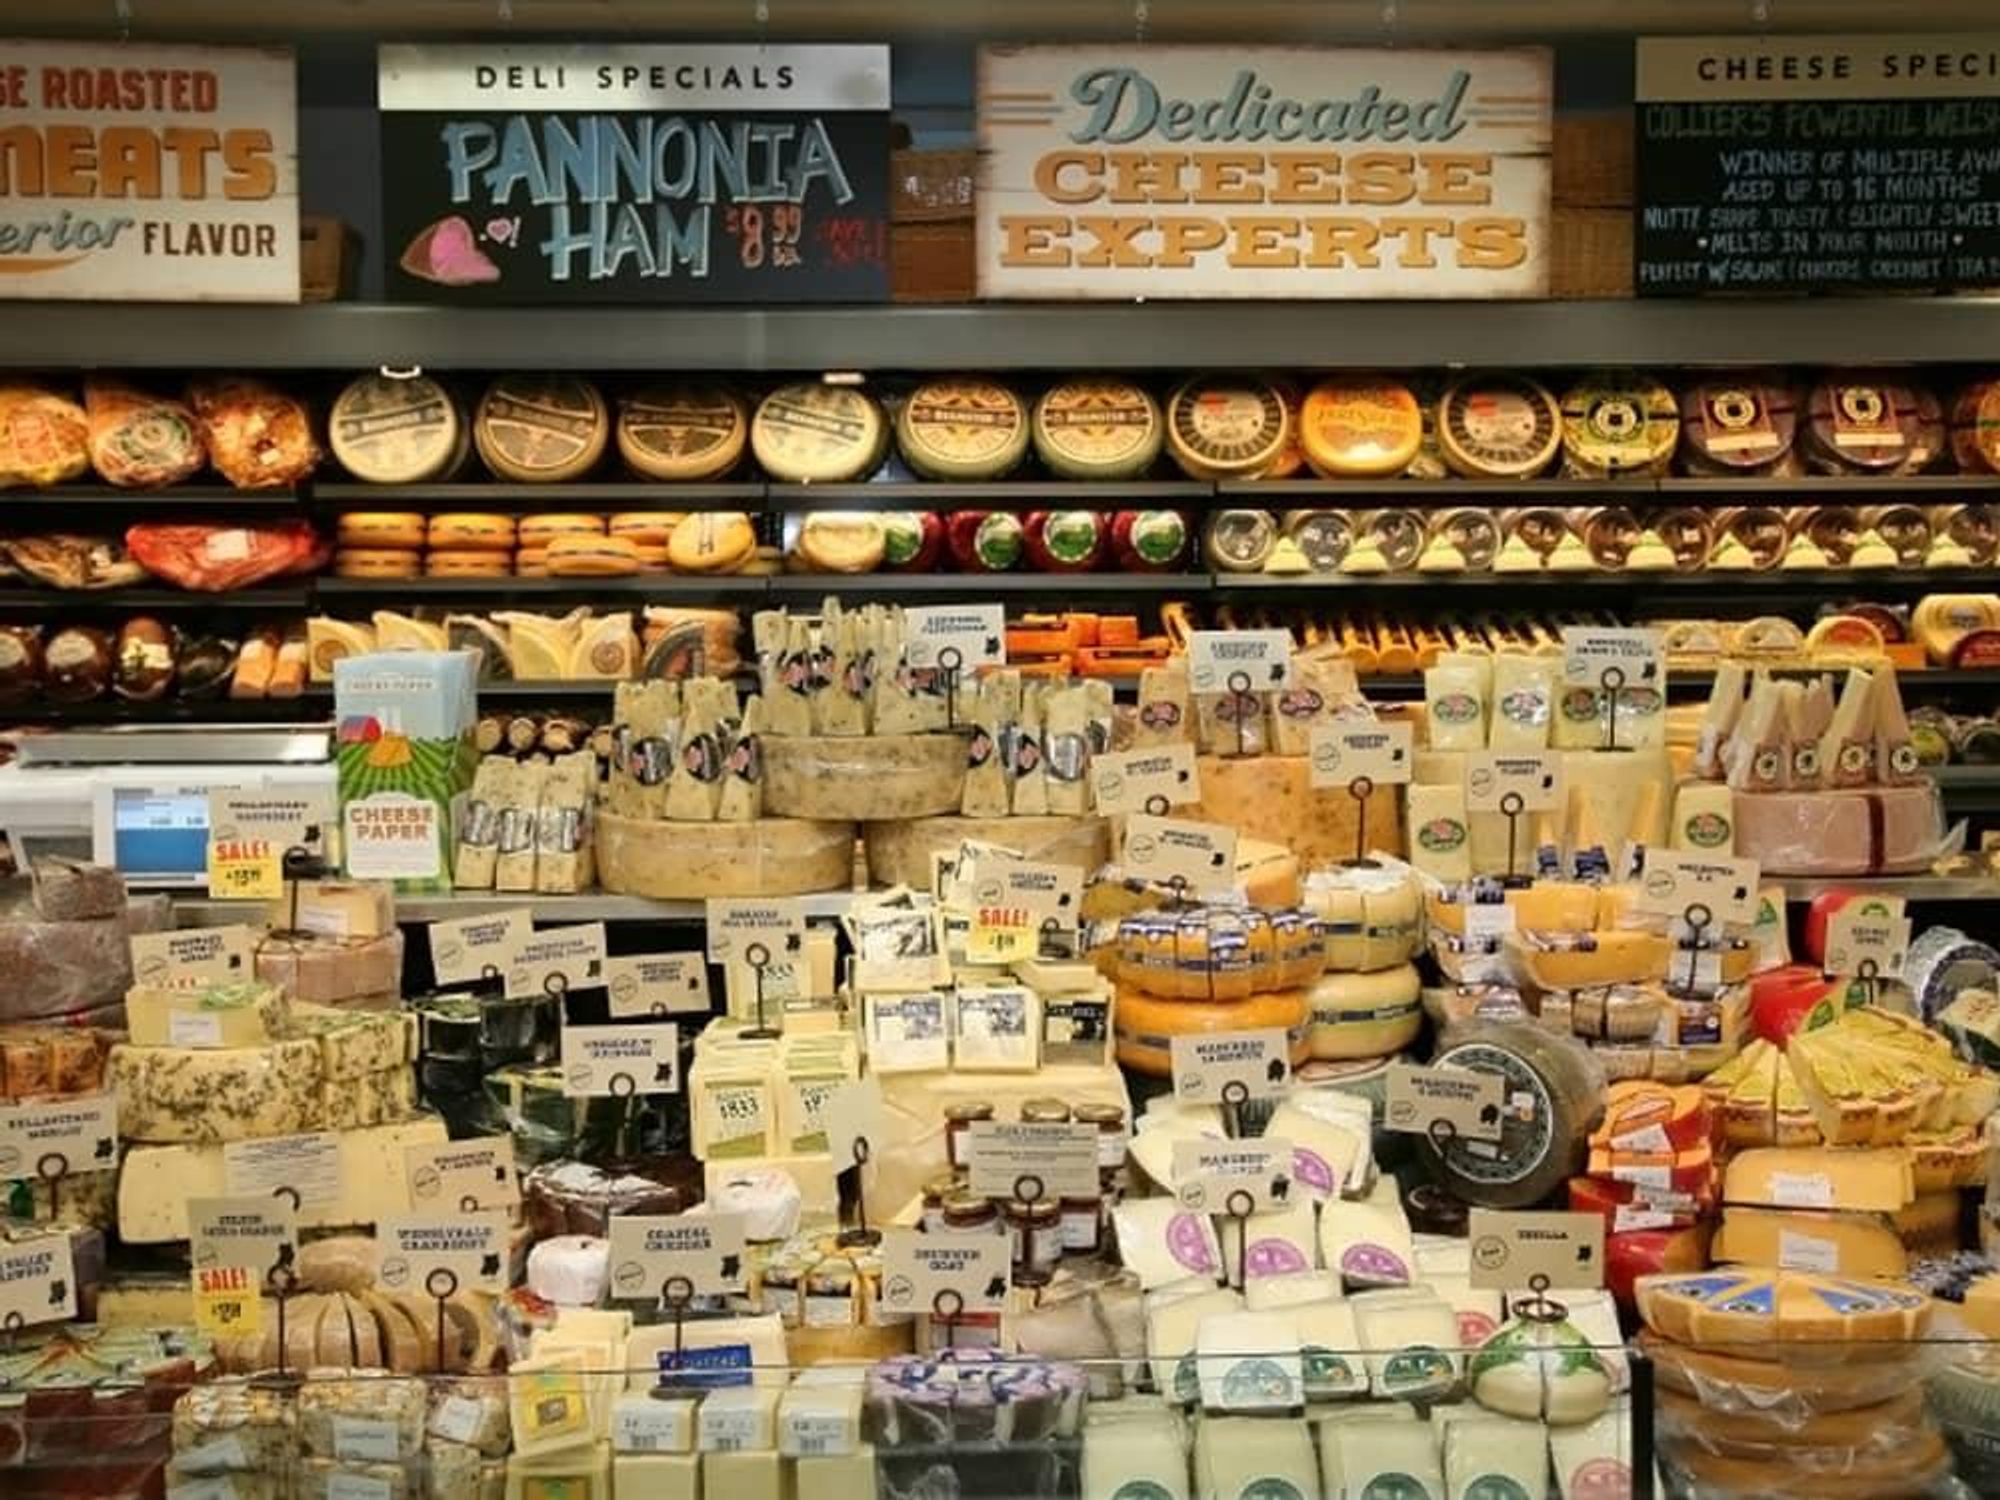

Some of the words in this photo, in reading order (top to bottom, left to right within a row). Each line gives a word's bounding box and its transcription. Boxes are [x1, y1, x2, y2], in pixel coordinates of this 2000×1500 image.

[475, 65, 566, 89] DELI
[597, 65, 796, 90] SPECIALS
[1697, 55, 1851, 81] CHEESE
[42, 68, 218, 113] ROASTED
[1068, 64, 1473, 144] Dedicated
[441, 115, 853, 205] PANNONIA
[1719, 150, 1813, 176] WINNER
[1821, 150, 1845, 173] OF
[1853, 149, 1953, 175] MULTIPLE
[1033, 150, 1494, 205] CHEESE
[1885, 175, 1981, 199] MONTHS
[143, 221, 277, 257] FLAVOR
[541, 200, 711, 279] HAM
[999, 215, 1528, 271] EXPERTS
[351, 807, 433, 824] CHEESE
[356, 824, 429, 840] PAPER
[216, 840, 270, 862] SALE!
[199, 1267, 248, 1292] SALE!
